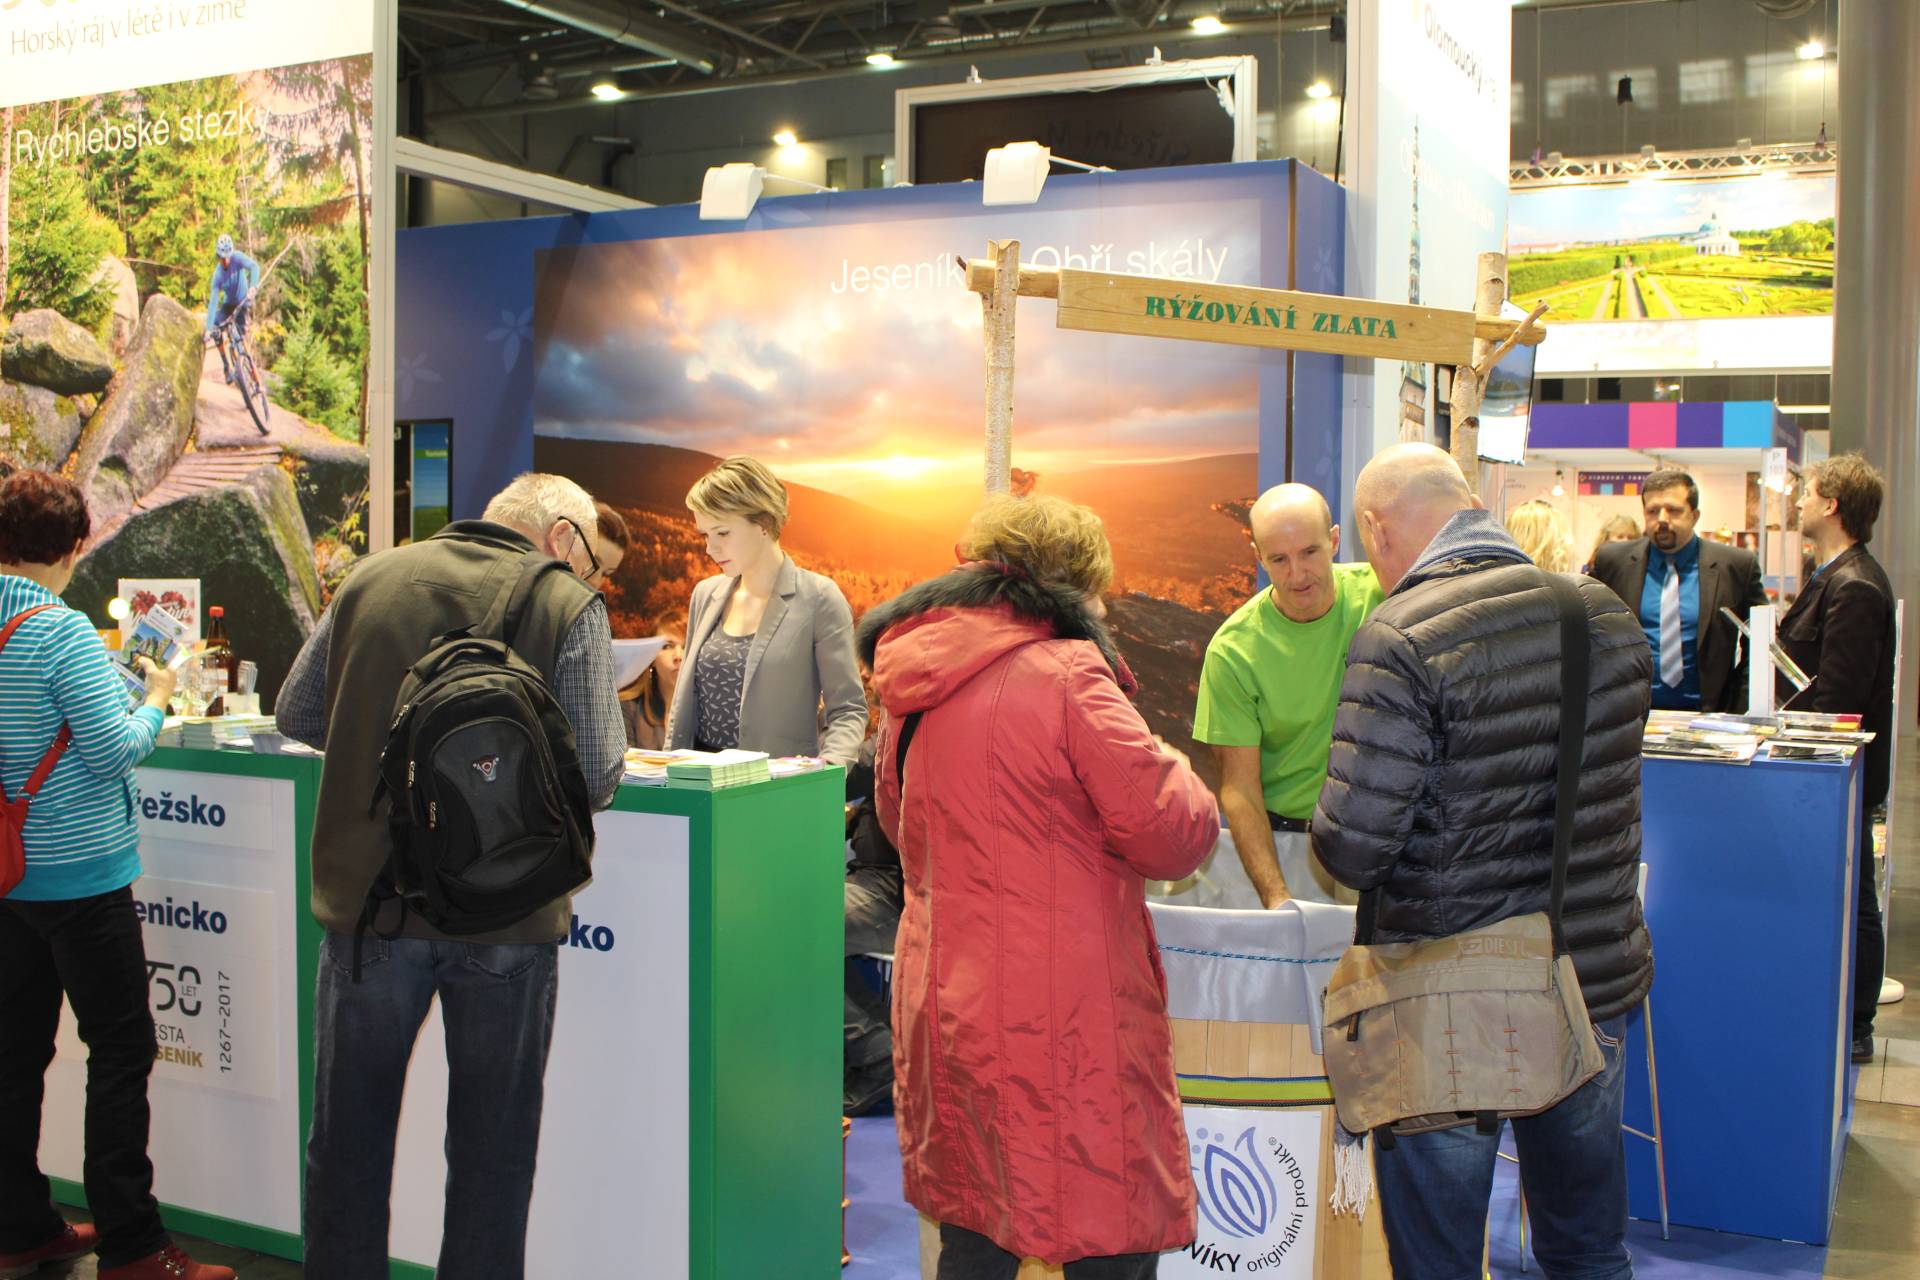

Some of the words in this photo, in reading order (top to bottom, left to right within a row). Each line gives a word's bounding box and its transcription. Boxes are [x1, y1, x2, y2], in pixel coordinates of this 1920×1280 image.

[12, 20, 78, 54] Horský
[83, 16, 105, 48] ráj
[111, 20, 121, 38] v
[127, 7, 164, 37] létě
[168, 3, 174, 29] i
[178, 8, 191, 27] v
[15, 111, 170, 169] Rychlebské
[179, 100, 271, 143] stezky
[1127, 238, 1228, 282] skály
[1145, 293, 1297, 330] RÝŽOVÁNÍ
[1312, 312, 1398, 339] ZLATA
[181, 985, 197, 997] LET
[1247, 1211, 1304, 1272] originální
